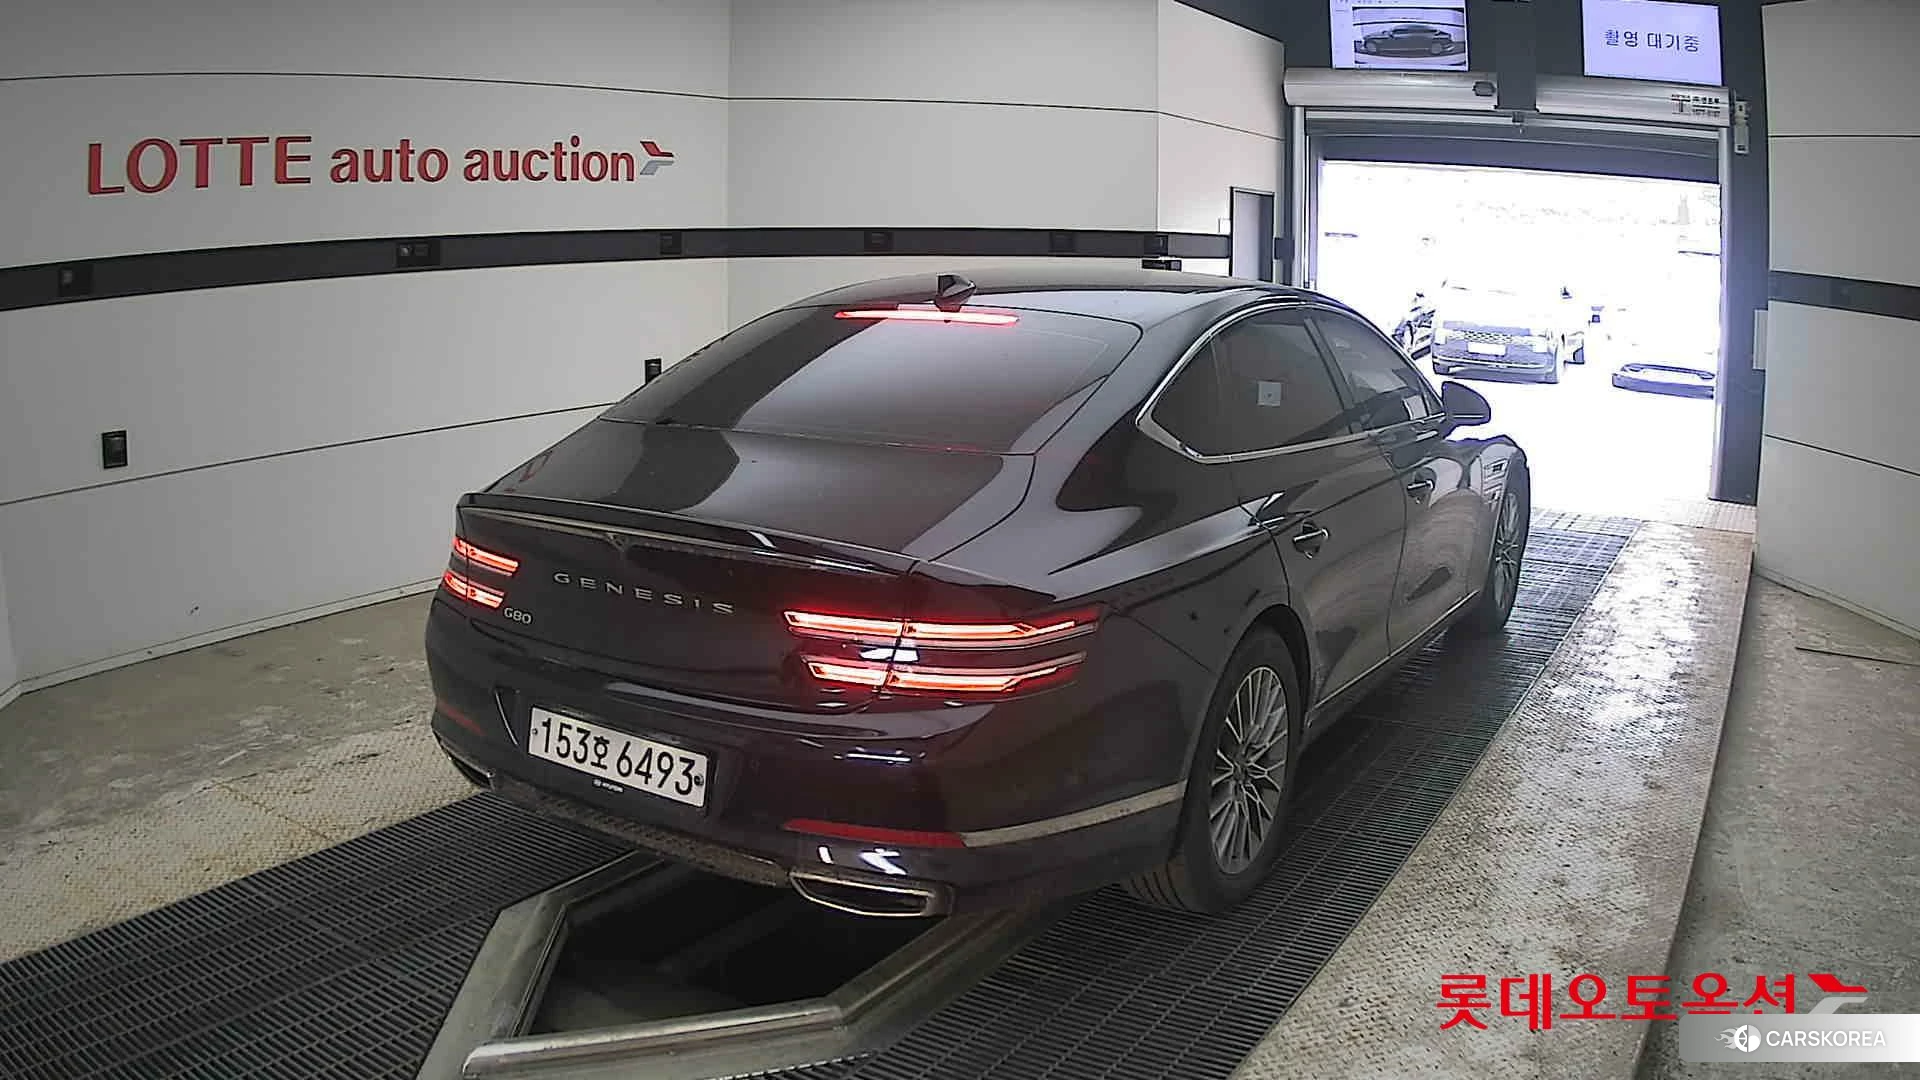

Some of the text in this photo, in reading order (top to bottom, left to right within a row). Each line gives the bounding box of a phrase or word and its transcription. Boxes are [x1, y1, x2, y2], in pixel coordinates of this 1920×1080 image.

[1647, 32, 1699, 52] 대기중
[88, 135, 635, 195] LOTTE auto auction
[553, 572, 734, 615] GENESIS
[503, 607, 532, 624] G80
[541, 717, 696, 796] 153호 6493
